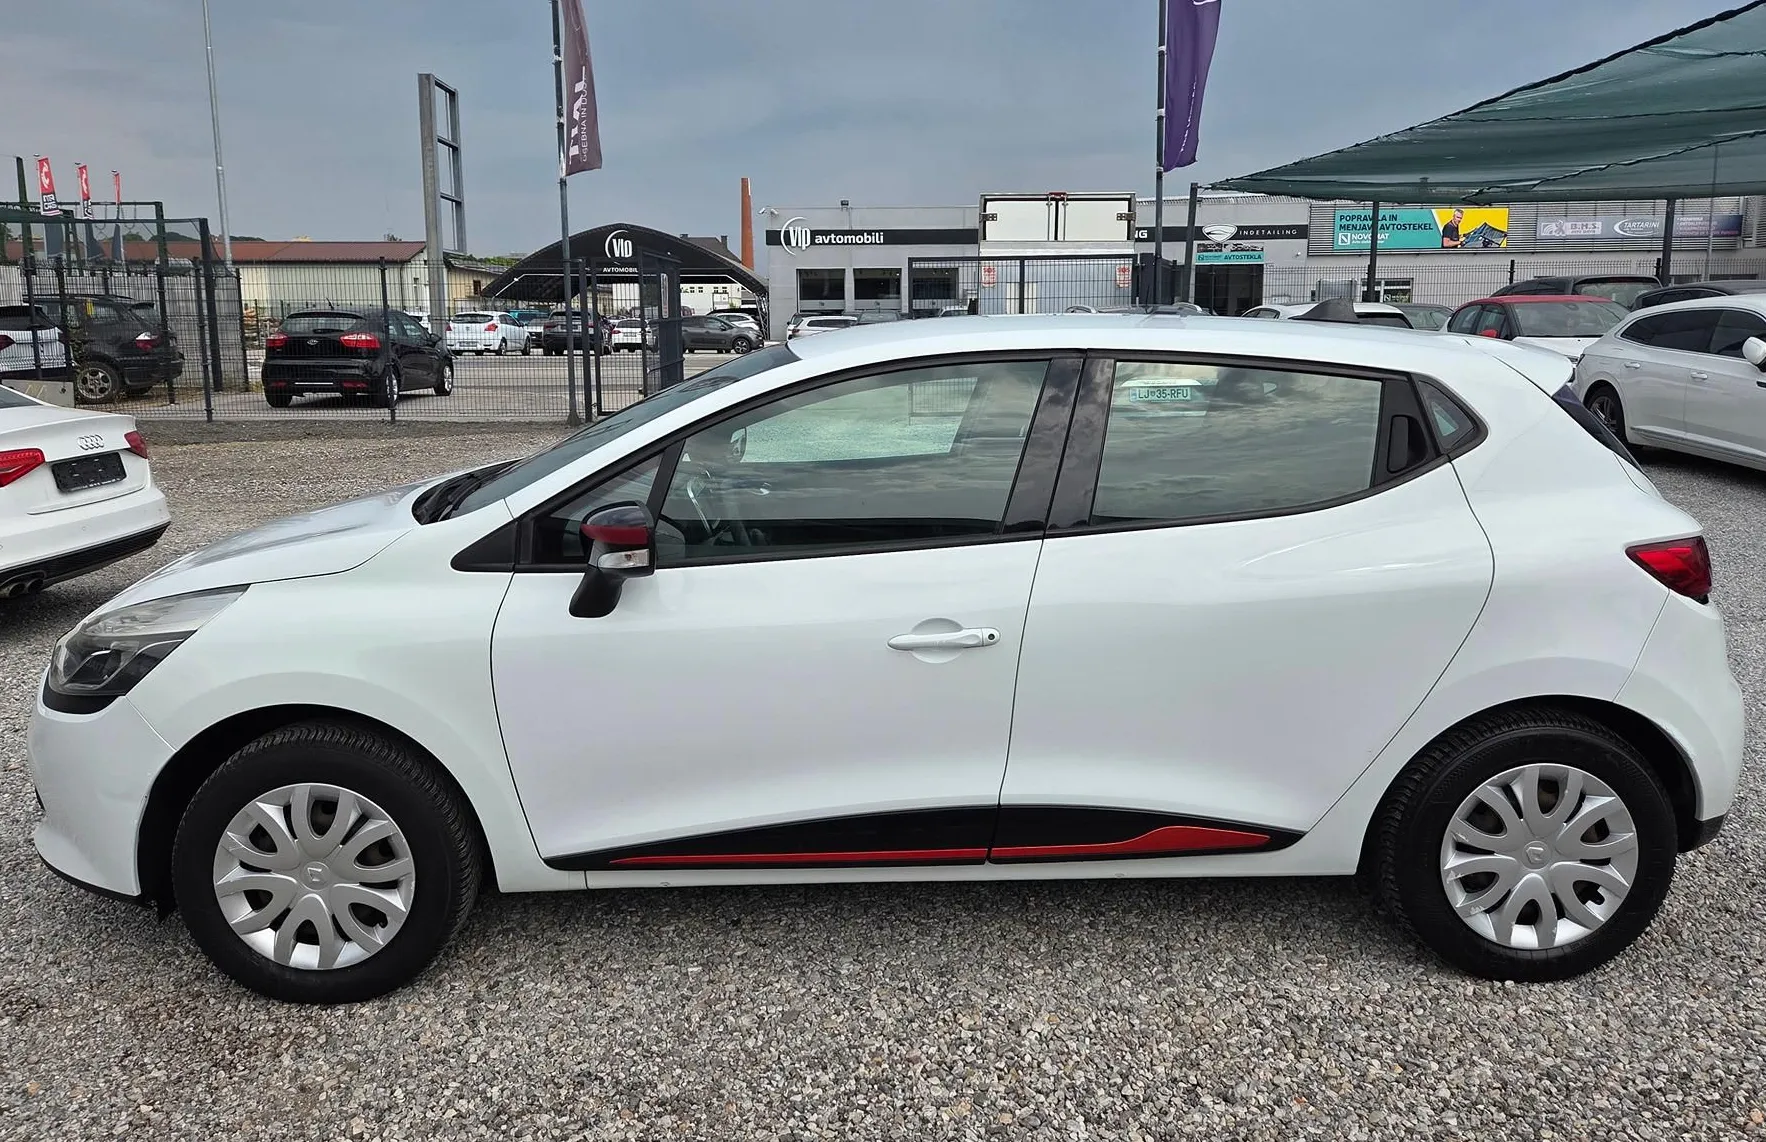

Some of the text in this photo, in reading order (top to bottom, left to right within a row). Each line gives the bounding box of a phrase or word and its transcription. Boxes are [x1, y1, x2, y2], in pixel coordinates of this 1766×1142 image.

[1339, 214, 1398, 222] POPRAVA IN
[1339, 223, 1434, 231] MENJAV AVTOSTEKEL
[1623, 221, 1660, 229] TARTARINI
[814, 232, 884, 244] avtomobili
[1138, 388, 1188, 399] LJ 35-RFU
